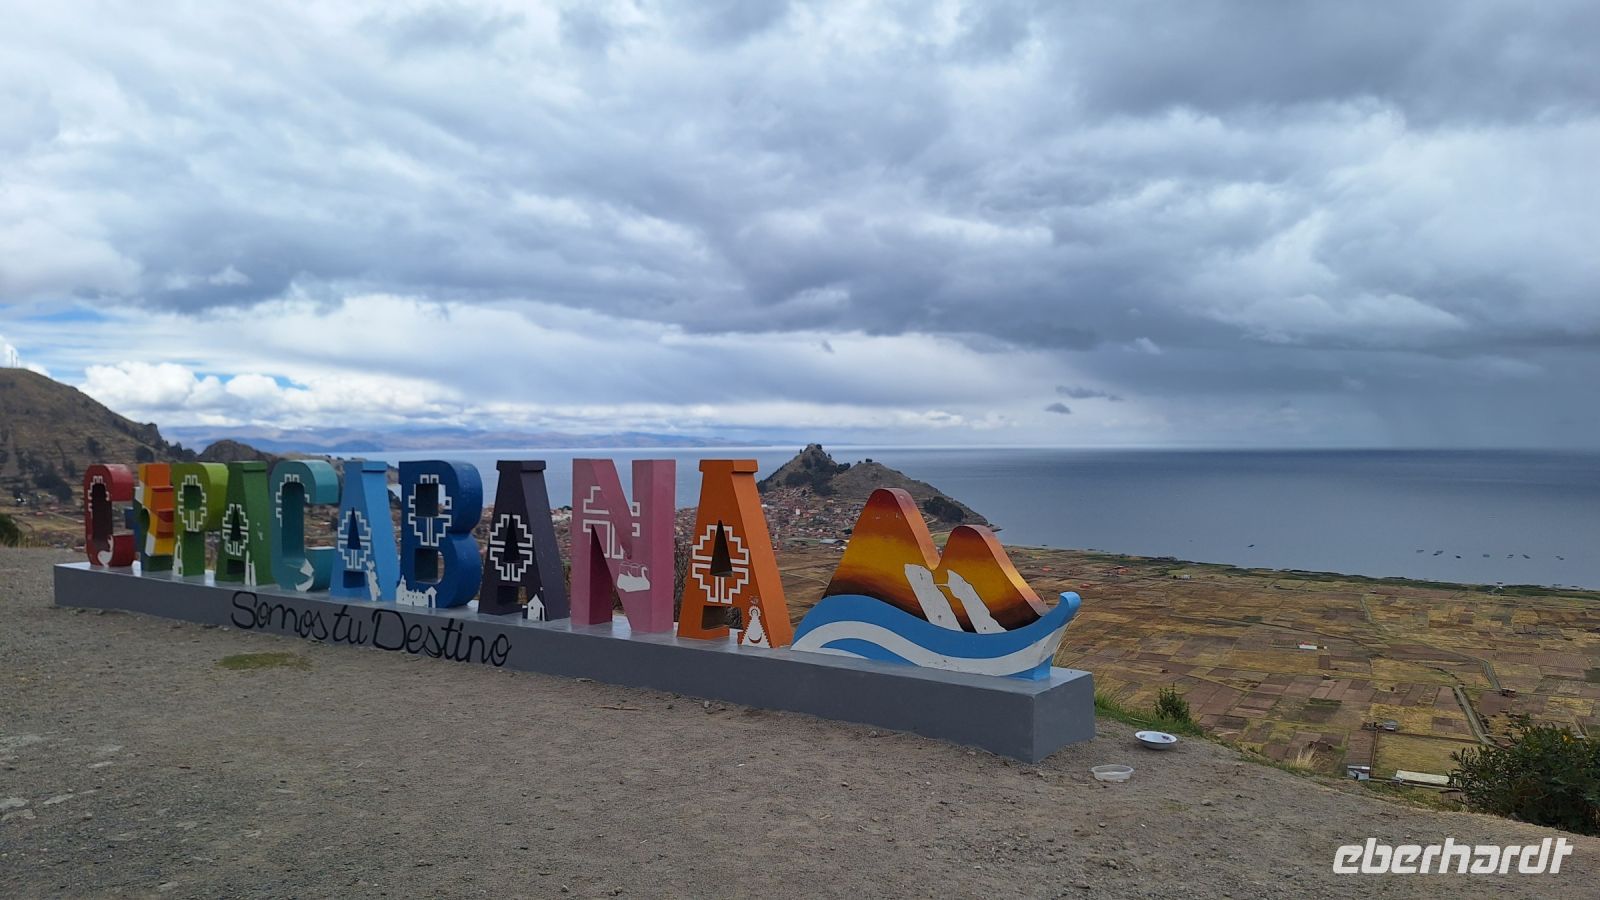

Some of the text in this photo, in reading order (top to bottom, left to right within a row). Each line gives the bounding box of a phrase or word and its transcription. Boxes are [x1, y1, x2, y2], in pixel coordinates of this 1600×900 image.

[231, 591, 512, 667] Somos tu Destino
